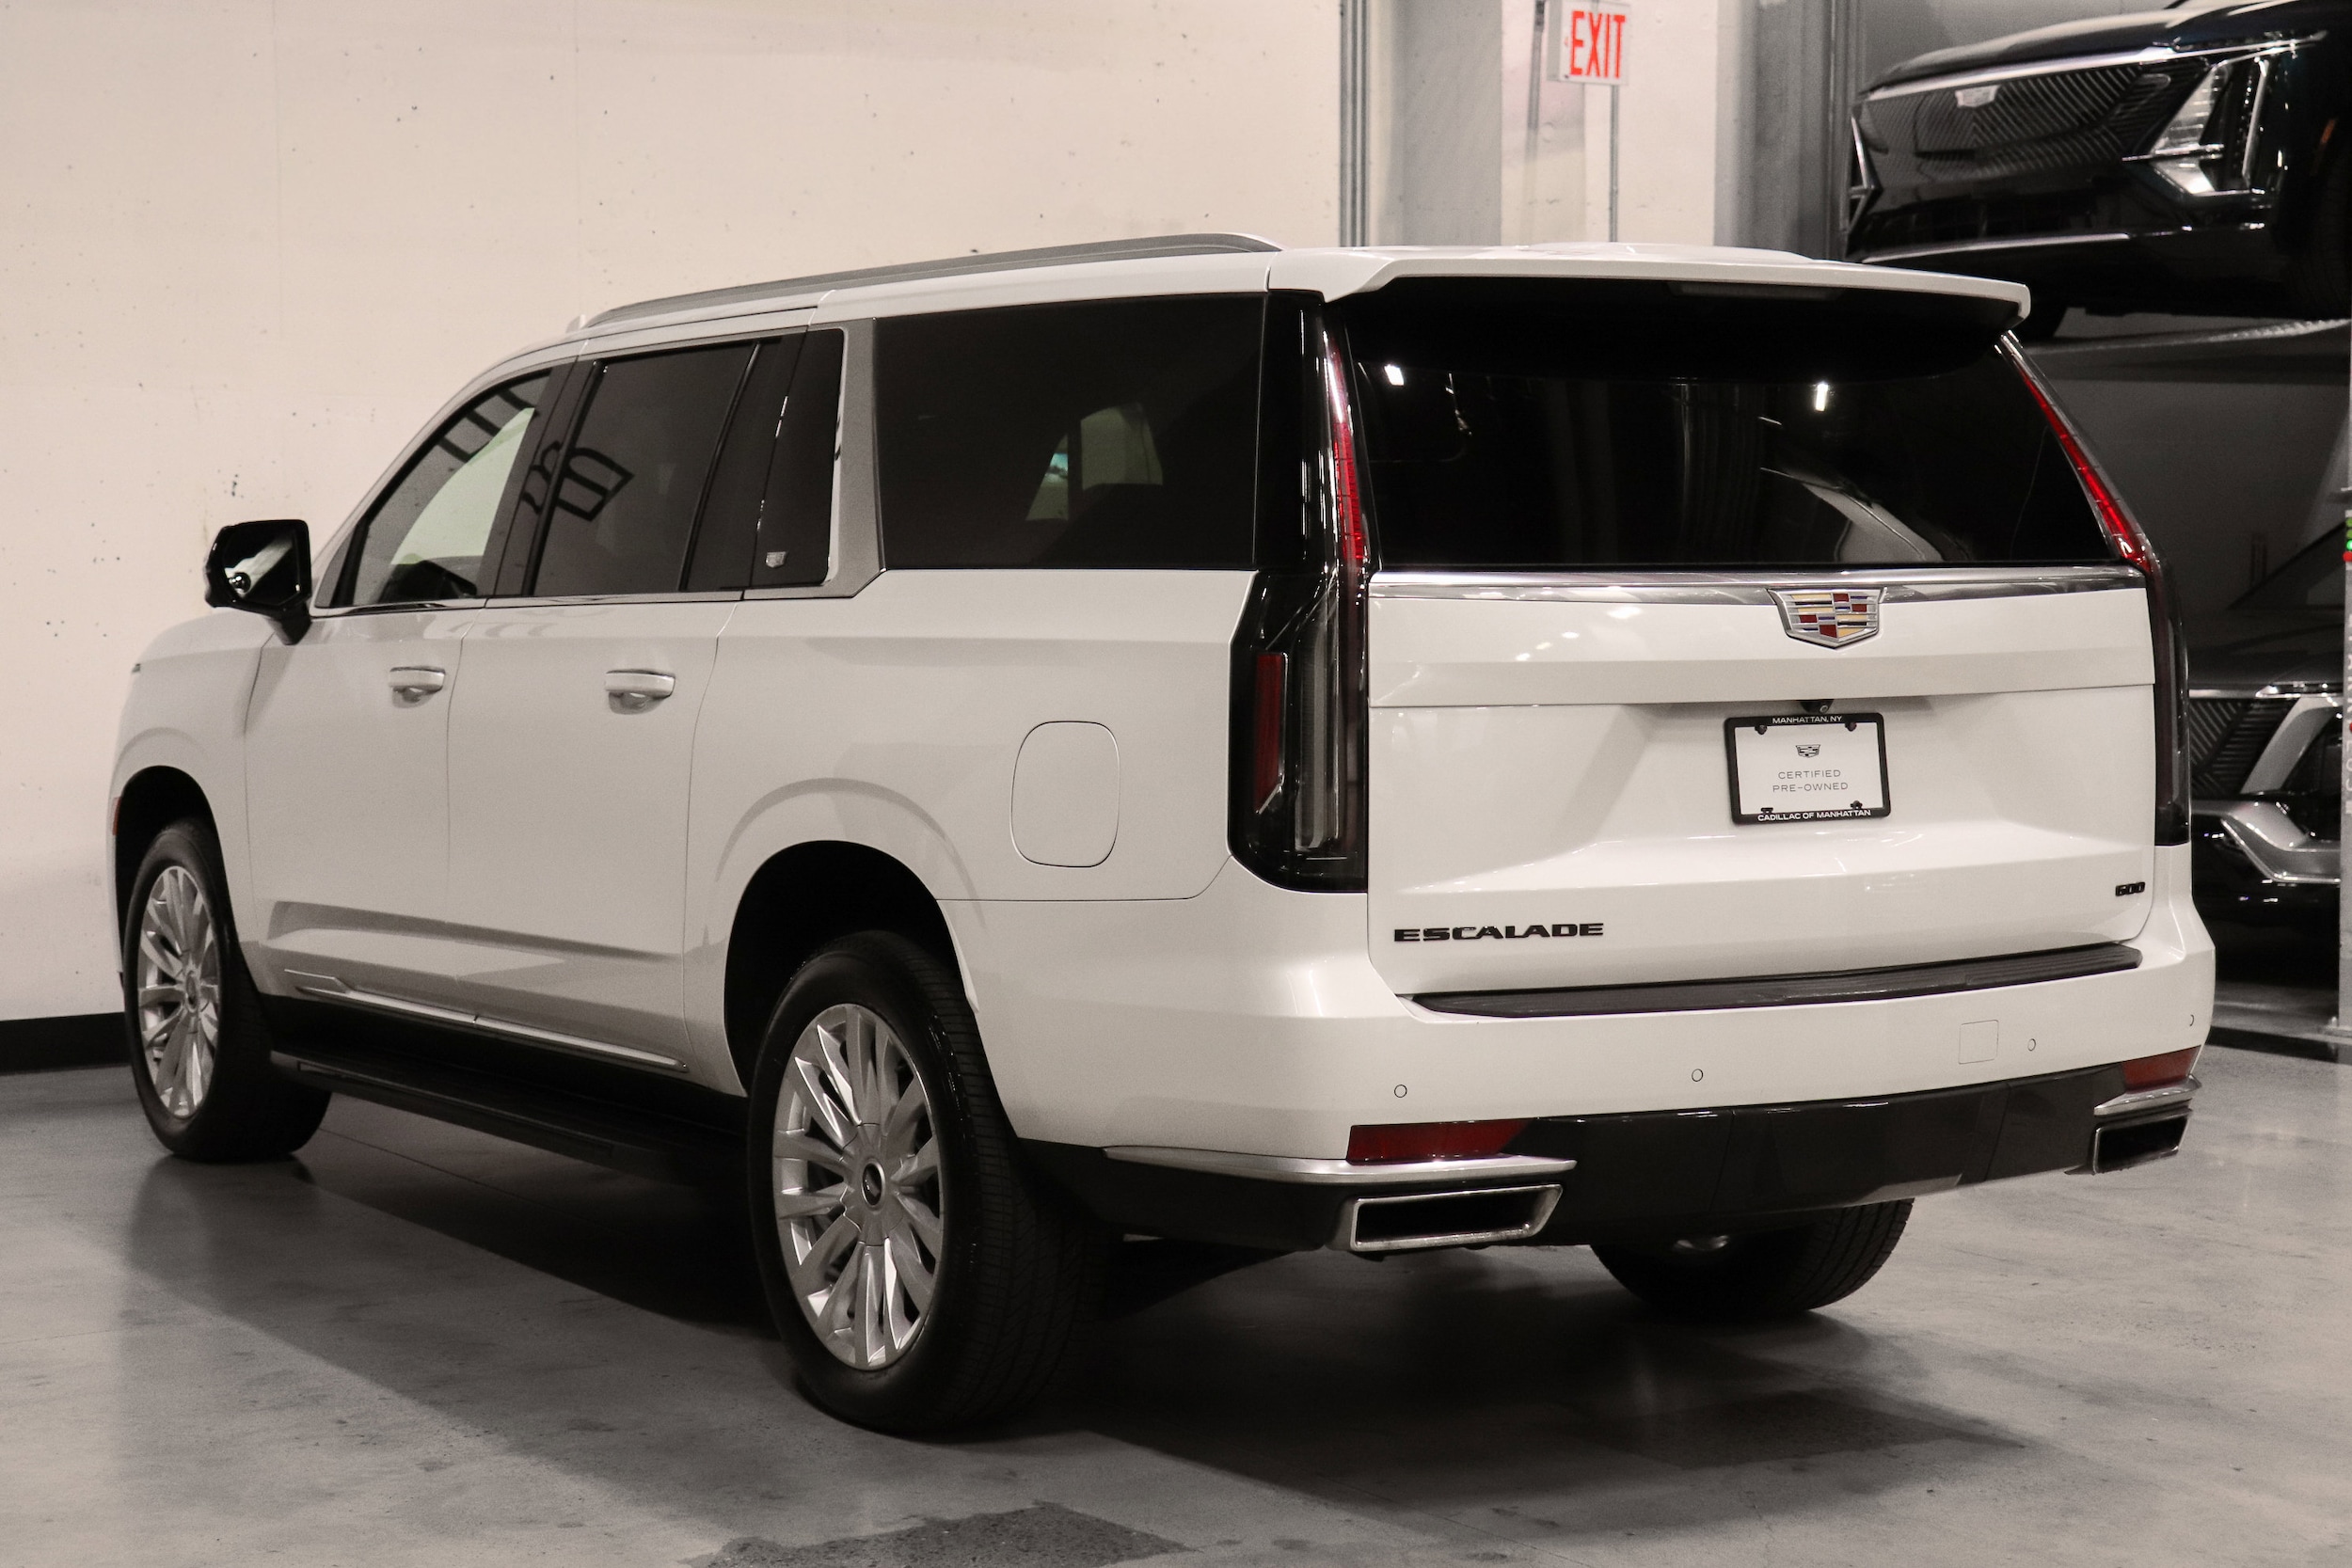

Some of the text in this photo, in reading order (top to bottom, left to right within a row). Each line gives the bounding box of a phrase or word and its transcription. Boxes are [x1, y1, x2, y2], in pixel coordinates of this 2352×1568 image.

[1570, 10, 1627, 79] EXIT
[1772, 716, 1829, 724] MANHATTAN,
[1777, 769, 1841, 780] CERTIFIED
[1772, 782, 1849, 792] PRE-OWNED
[1816, 809, 1872, 818] MANHATTAN
[2115, 881, 2146, 896] 600
[1393, 923, 1604, 942] ESCALADE
